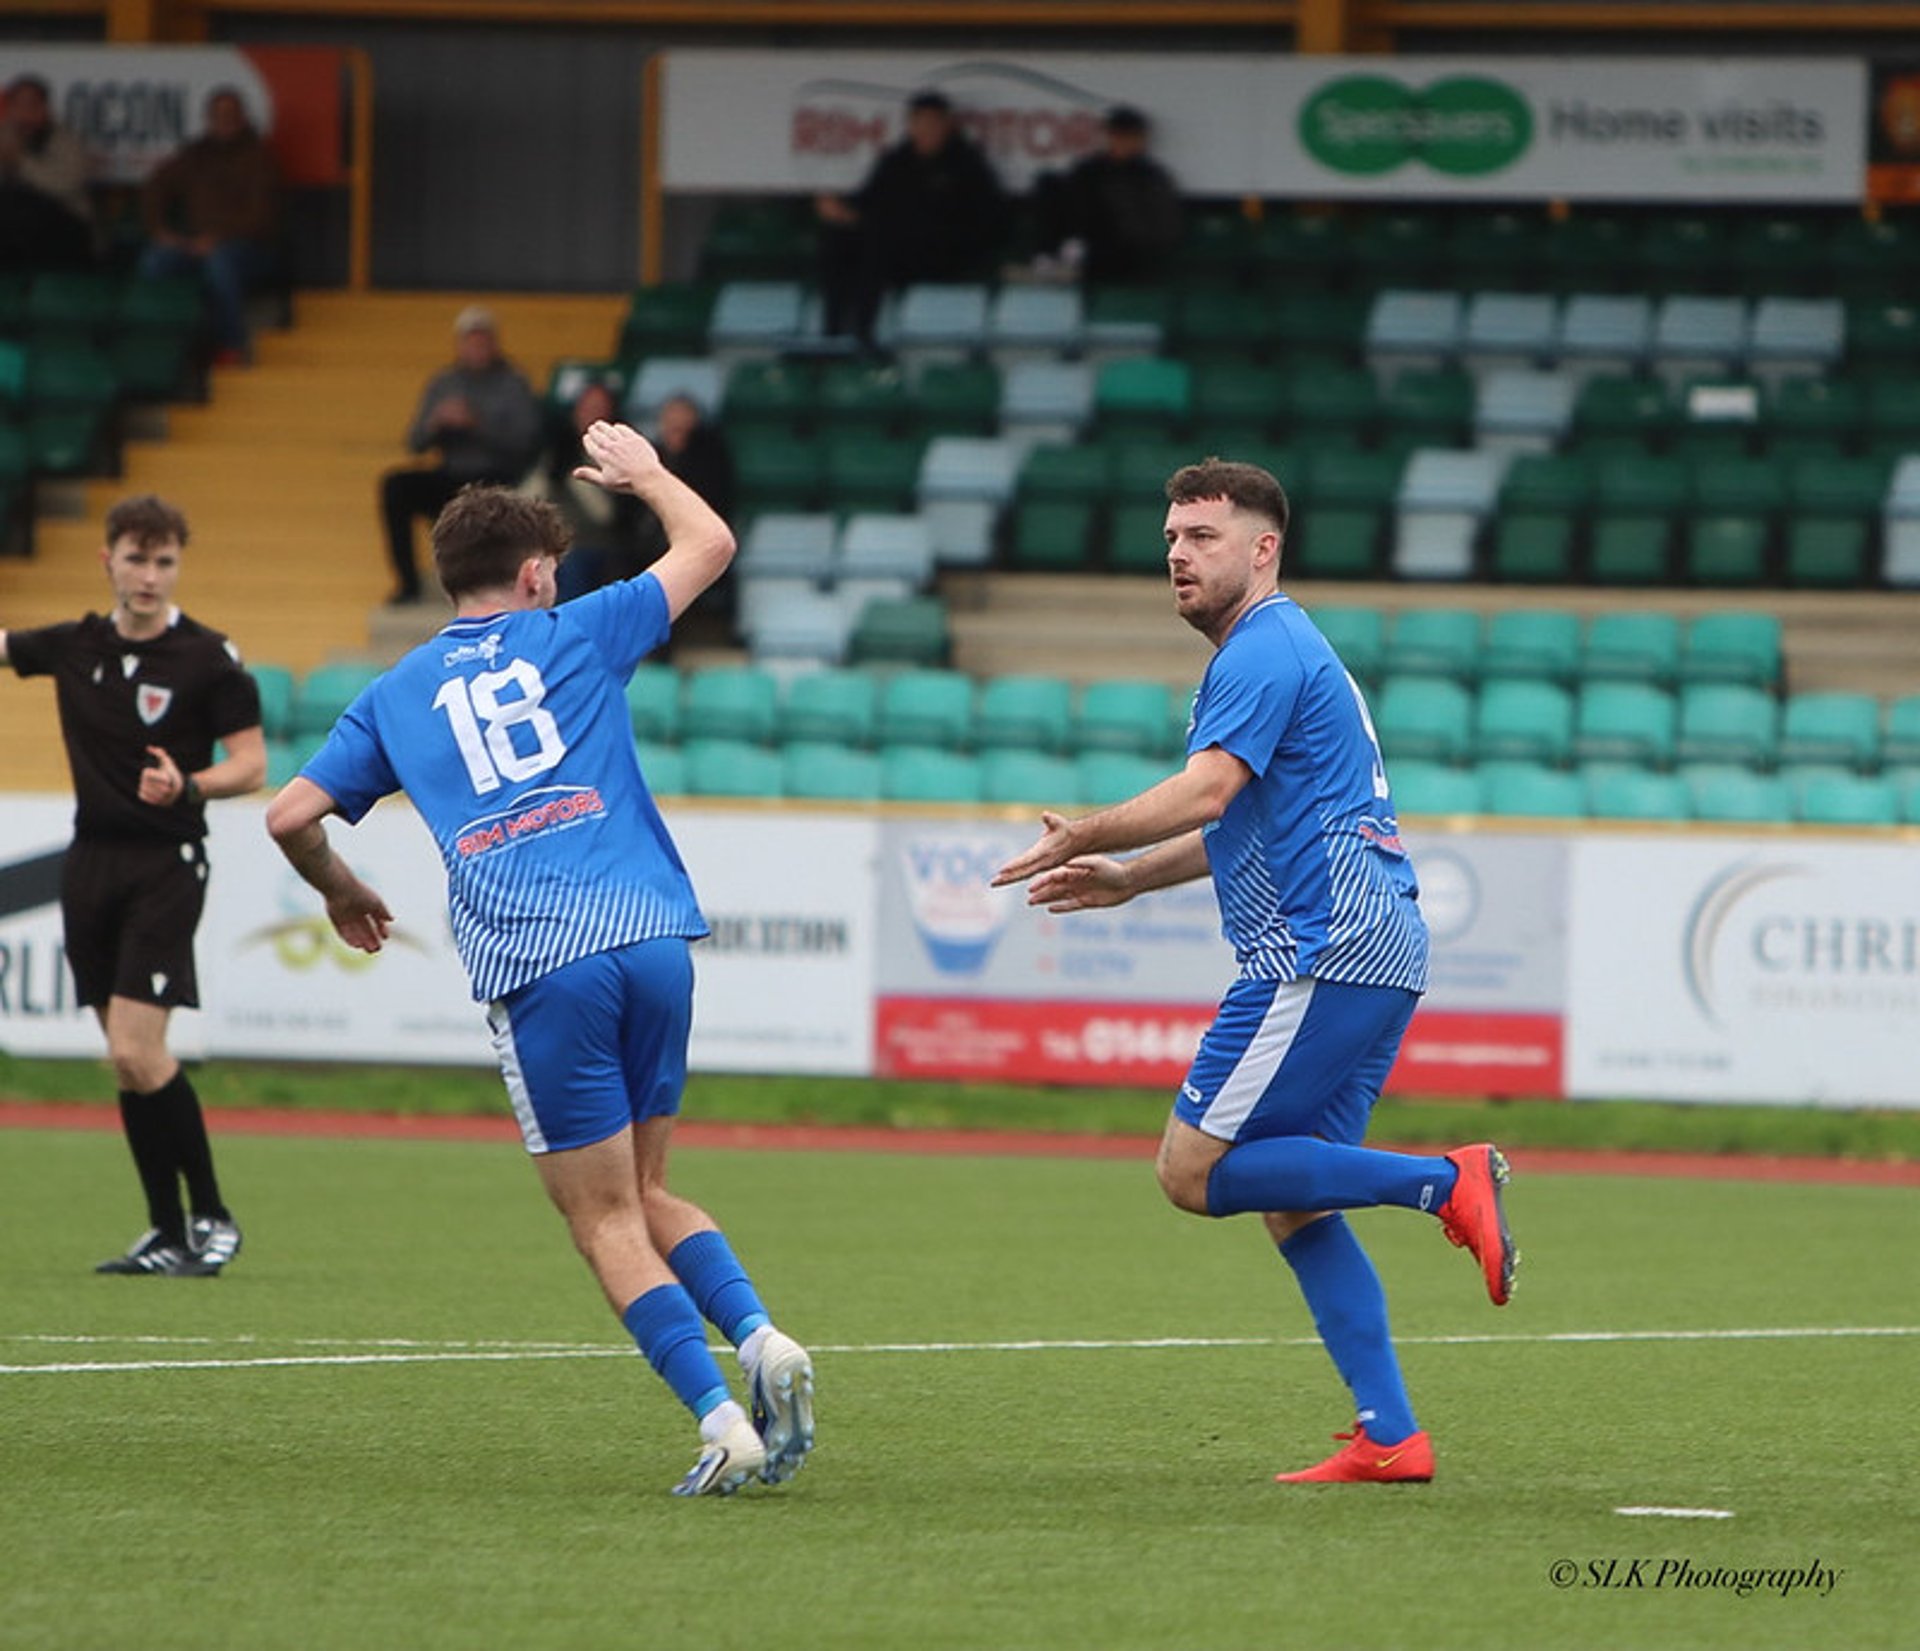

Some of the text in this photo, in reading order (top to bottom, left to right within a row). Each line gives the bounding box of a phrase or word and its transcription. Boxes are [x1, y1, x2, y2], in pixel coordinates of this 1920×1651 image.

[1551, 101, 1827, 142] Home visits
[432, 657, 567, 796] 18
[456, 789, 604, 858] RIM MOTORS
